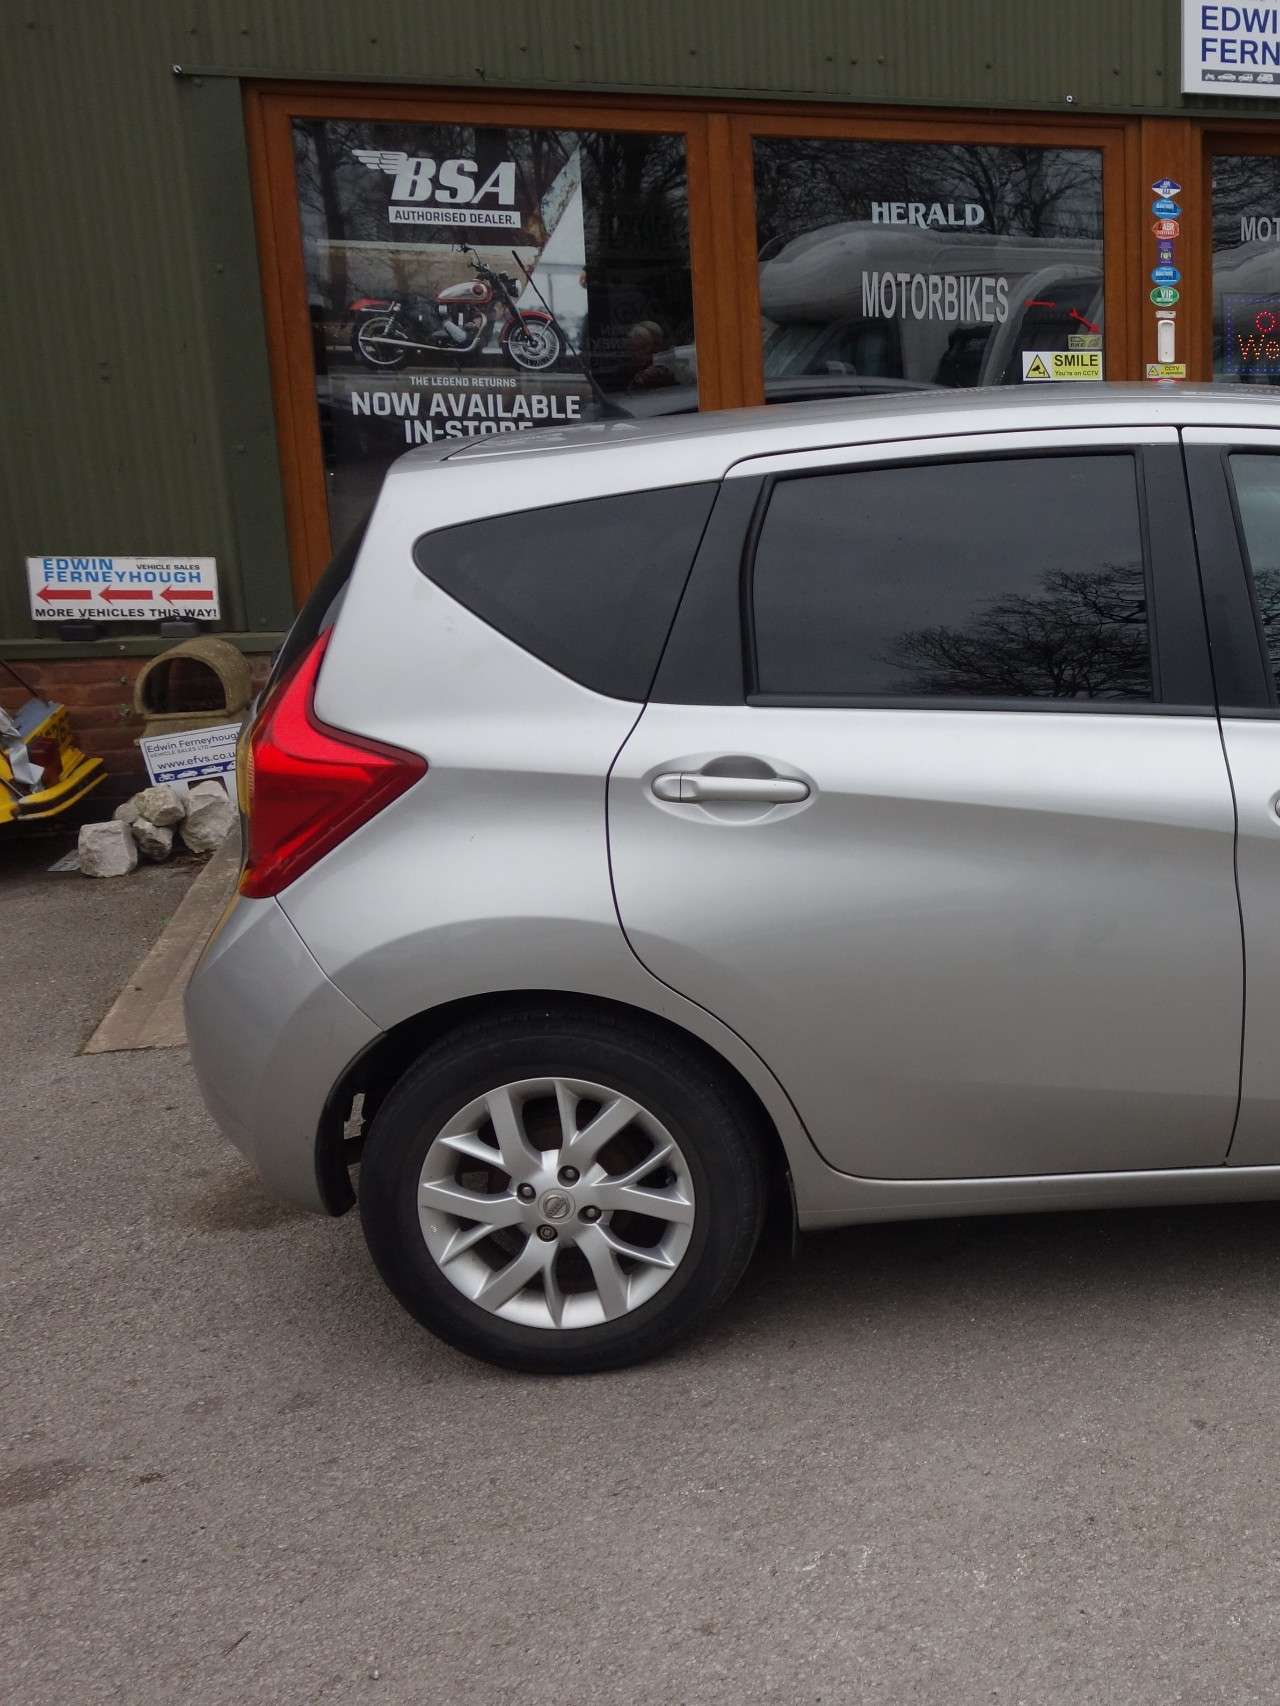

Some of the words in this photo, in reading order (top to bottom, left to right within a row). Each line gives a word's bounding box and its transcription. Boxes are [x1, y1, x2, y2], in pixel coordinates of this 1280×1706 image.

[390, 157, 516, 205] BSA
[394, 210, 467, 223] AUTHORISED
[470, 213, 516, 225] DEALER.
[871, 201, 985, 229] HERALD
[862, 270, 1009, 323] MOTORBIKES
[1160, 289, 1174, 298] VIP
[1054, 354, 1099, 367] SMILE
[409, 376, 430, 386] THE
[432, 376, 469, 387] LEGEND
[472, 377, 517, 388] RETURNS
[351, 391, 421, 416] NOW
[430, 393, 582, 419] AVAILABLE
[42, 558, 113, 571] EDWIN
[43, 571, 201, 583] FERNEYHOUGH
[35, 608, 74, 618] MORE
[78, 608, 145, 618] VEHICLES
[150, 608, 180, 618] THIS
[184, 608, 217, 618] WAY!
[146, 742, 177, 753] Edwin
[157, 751, 236, 769] www.efvs.co.u
